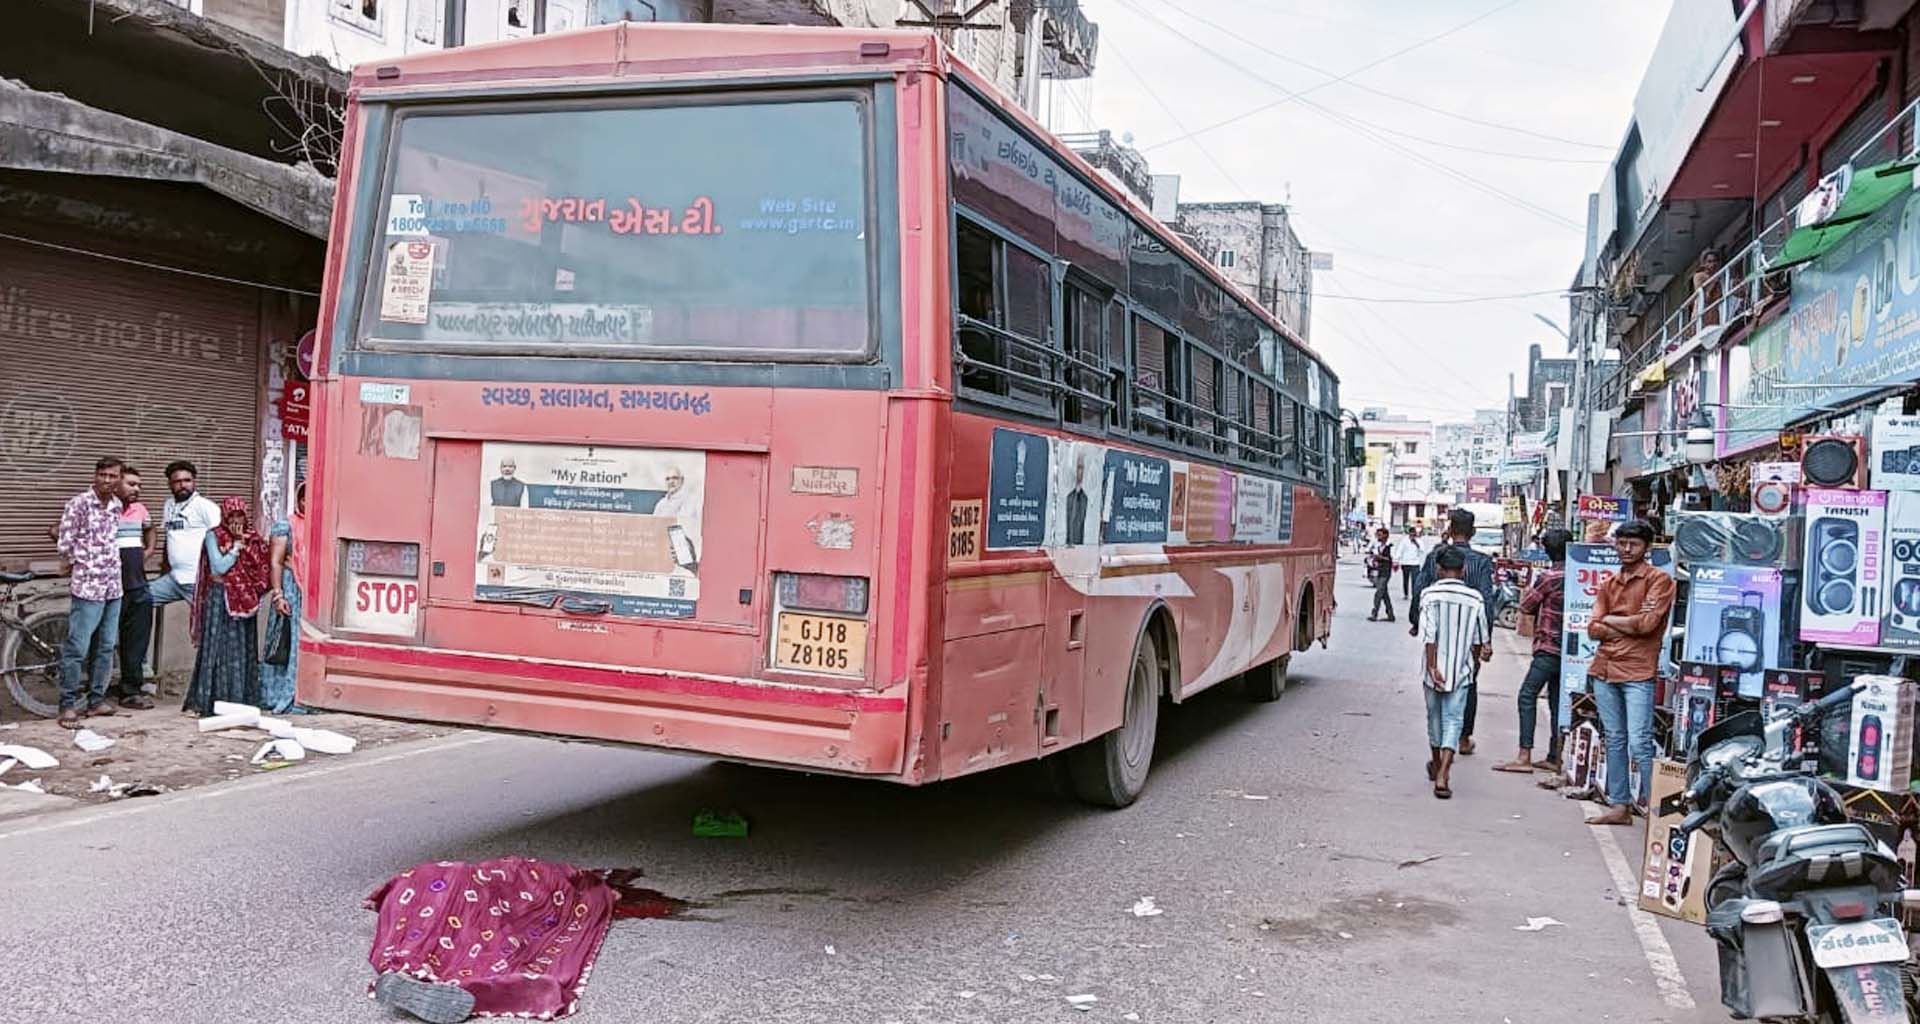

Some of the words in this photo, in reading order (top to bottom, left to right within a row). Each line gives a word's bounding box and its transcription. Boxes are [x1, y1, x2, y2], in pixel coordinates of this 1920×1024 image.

[519, 196, 606, 233] ગુજરાત
[760, 199, 796, 214] Web
[800, 198, 837, 214] Site
[481, 386, 536, 411] સ્વચ્છ,
[539, 387, 614, 412] સલામત,
[619, 389, 711, 416] સમયબદ્ધ
[551, 468, 572, 484] "My
[579, 470, 628, 484] Ration"
[950, 530, 975, 558] 8185
[356, 581, 418, 614] STOP
[800, 619, 847, 643] GJ18
[790, 643, 848, 669] Z8185
